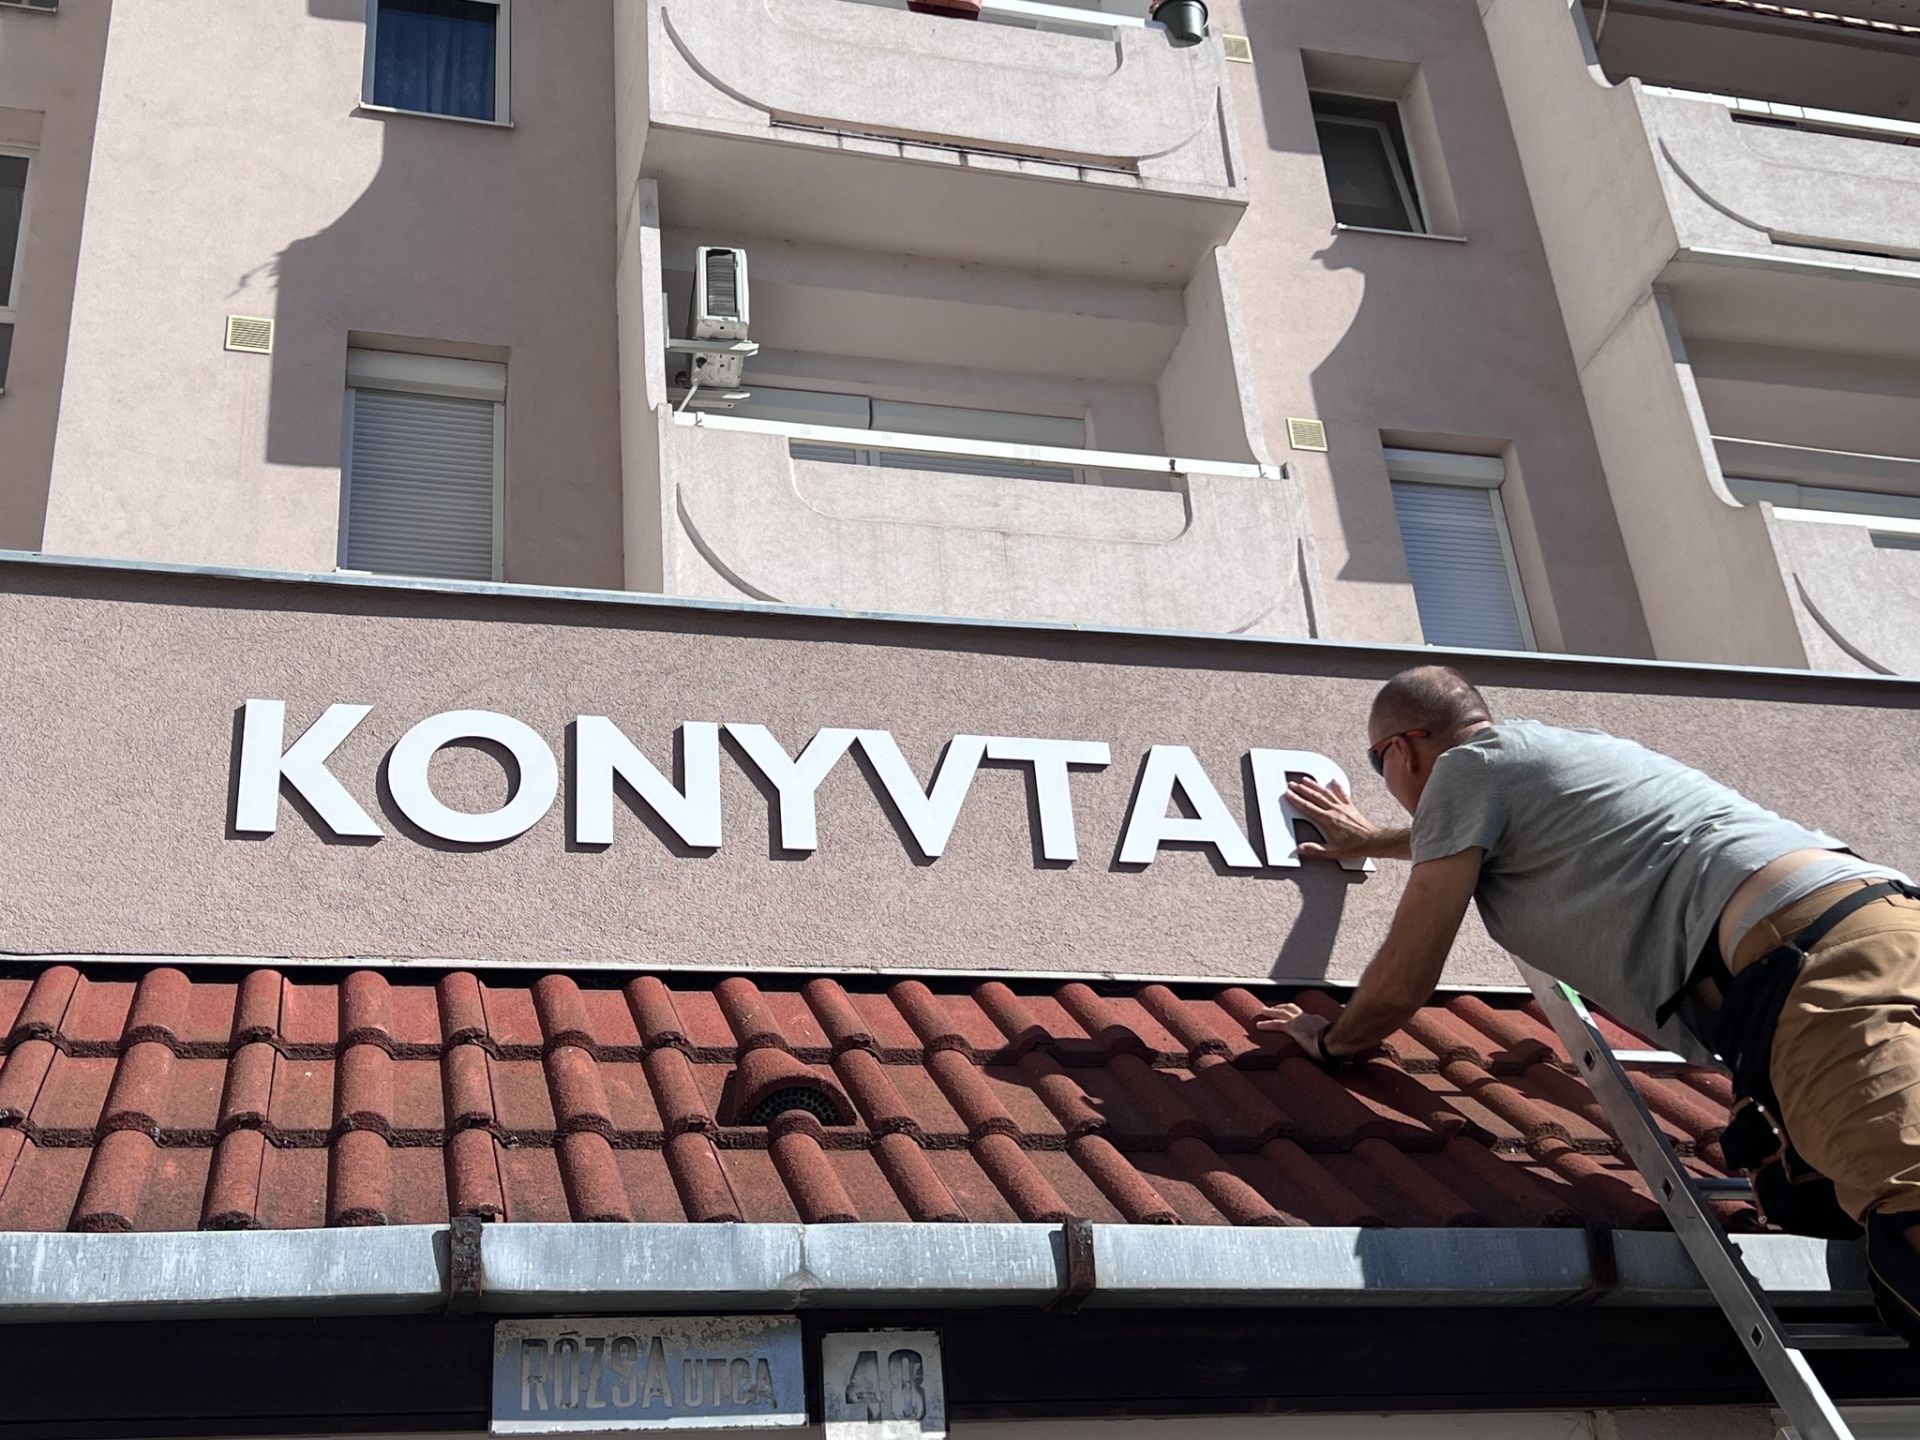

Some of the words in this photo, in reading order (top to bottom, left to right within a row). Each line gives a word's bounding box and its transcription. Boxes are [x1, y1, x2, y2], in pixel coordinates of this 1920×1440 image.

[235, 698, 1377, 873] KONYVTAR
[521, 1330, 673, 1411] RÓZSA
[682, 1357, 778, 1409] UTCA
[845, 1348, 927, 1425] 48
